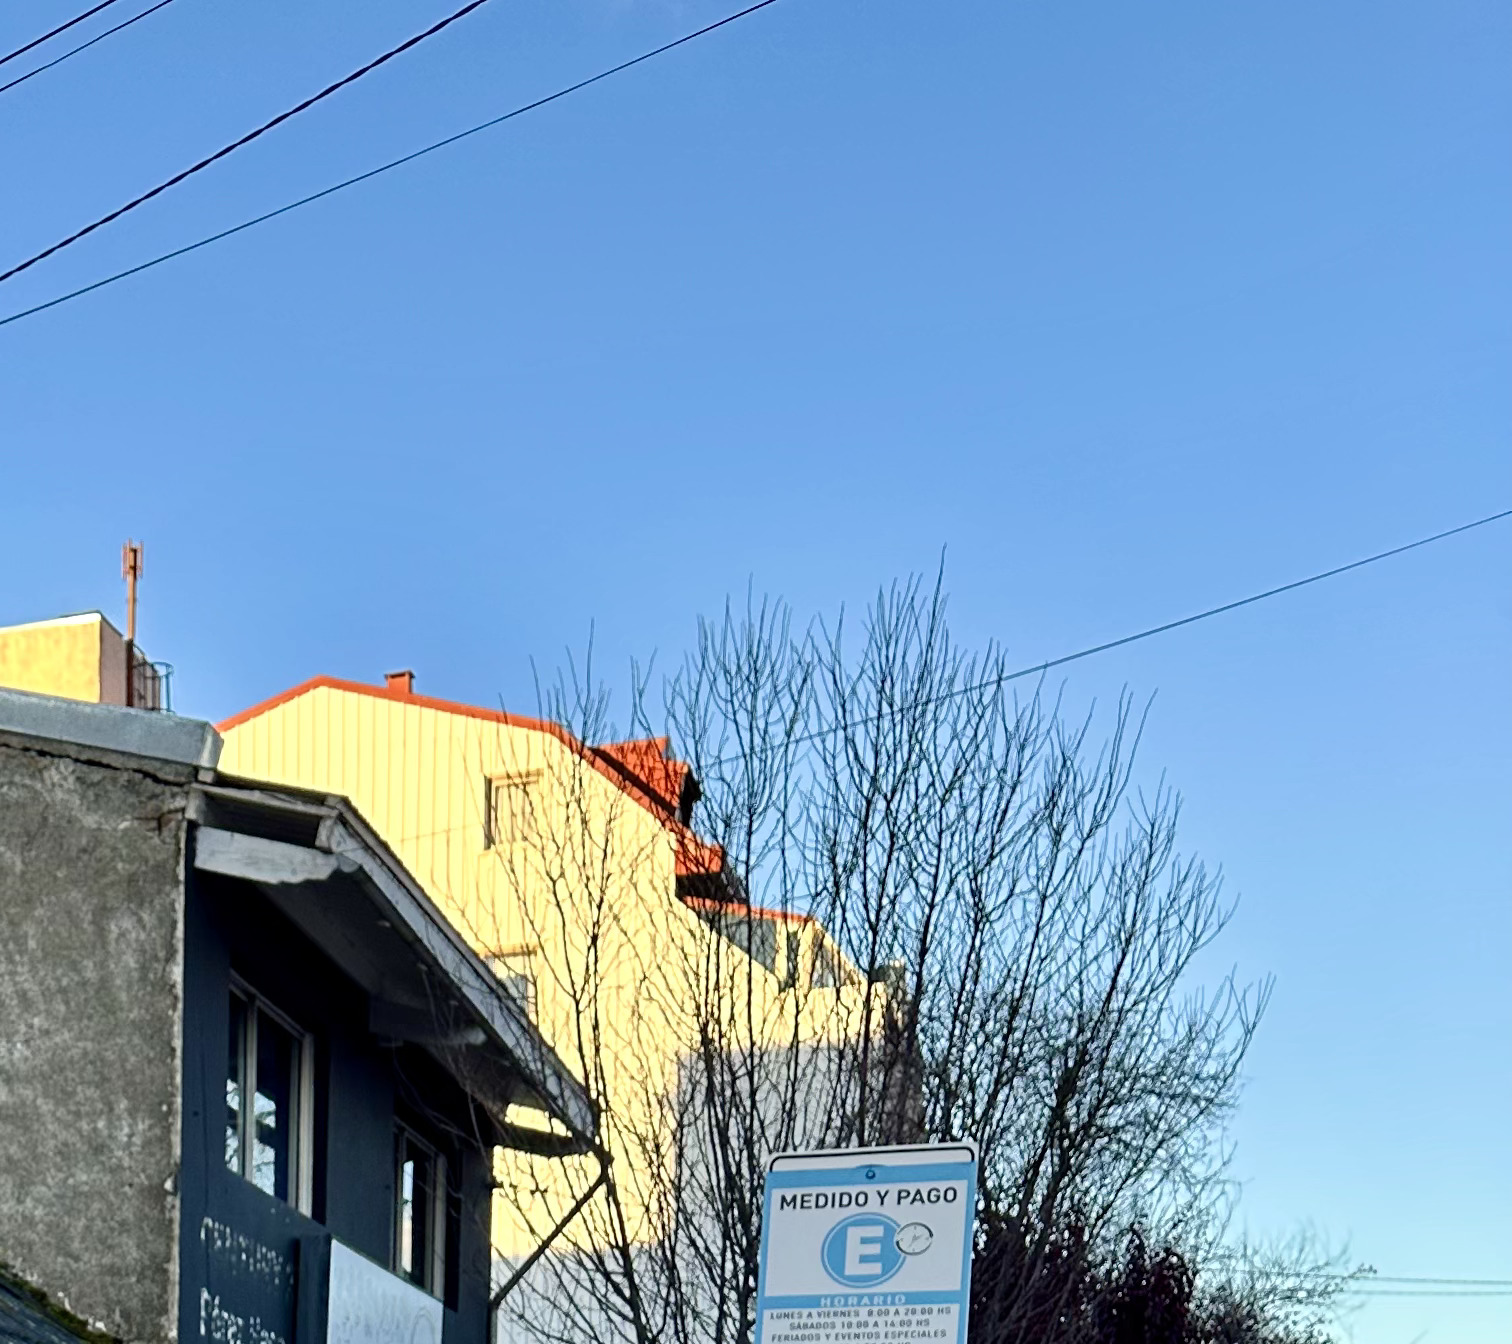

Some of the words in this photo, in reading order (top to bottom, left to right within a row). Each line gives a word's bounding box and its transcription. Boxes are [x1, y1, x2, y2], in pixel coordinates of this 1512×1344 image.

[780, 1190, 869, 1211] MEDIDO
[876, 1189, 889, 1206] Y
[896, 1186, 958, 1206] PAGO
[844, 1225, 884, 1276] E
[819, 1294, 907, 1308] HORARIO
[769, 1311, 803, 1321] LUNES
[806, 1311, 814, 1319] A
[816, 1309, 861, 1320] VIERNES
[893, 1308, 900, 1317] A
[937, 1306, 952, 1315] HS
[872, 1320, 879, 1329] A
[916, 1318, 930, 1327] HS
[771, 1332, 821, 1343] FERIADOS
[825, 1332, 832, 1341] Y
[834, 1331, 880, 1342] EVENTOS
[884, 1329, 947, 1339] ESPECIALES
